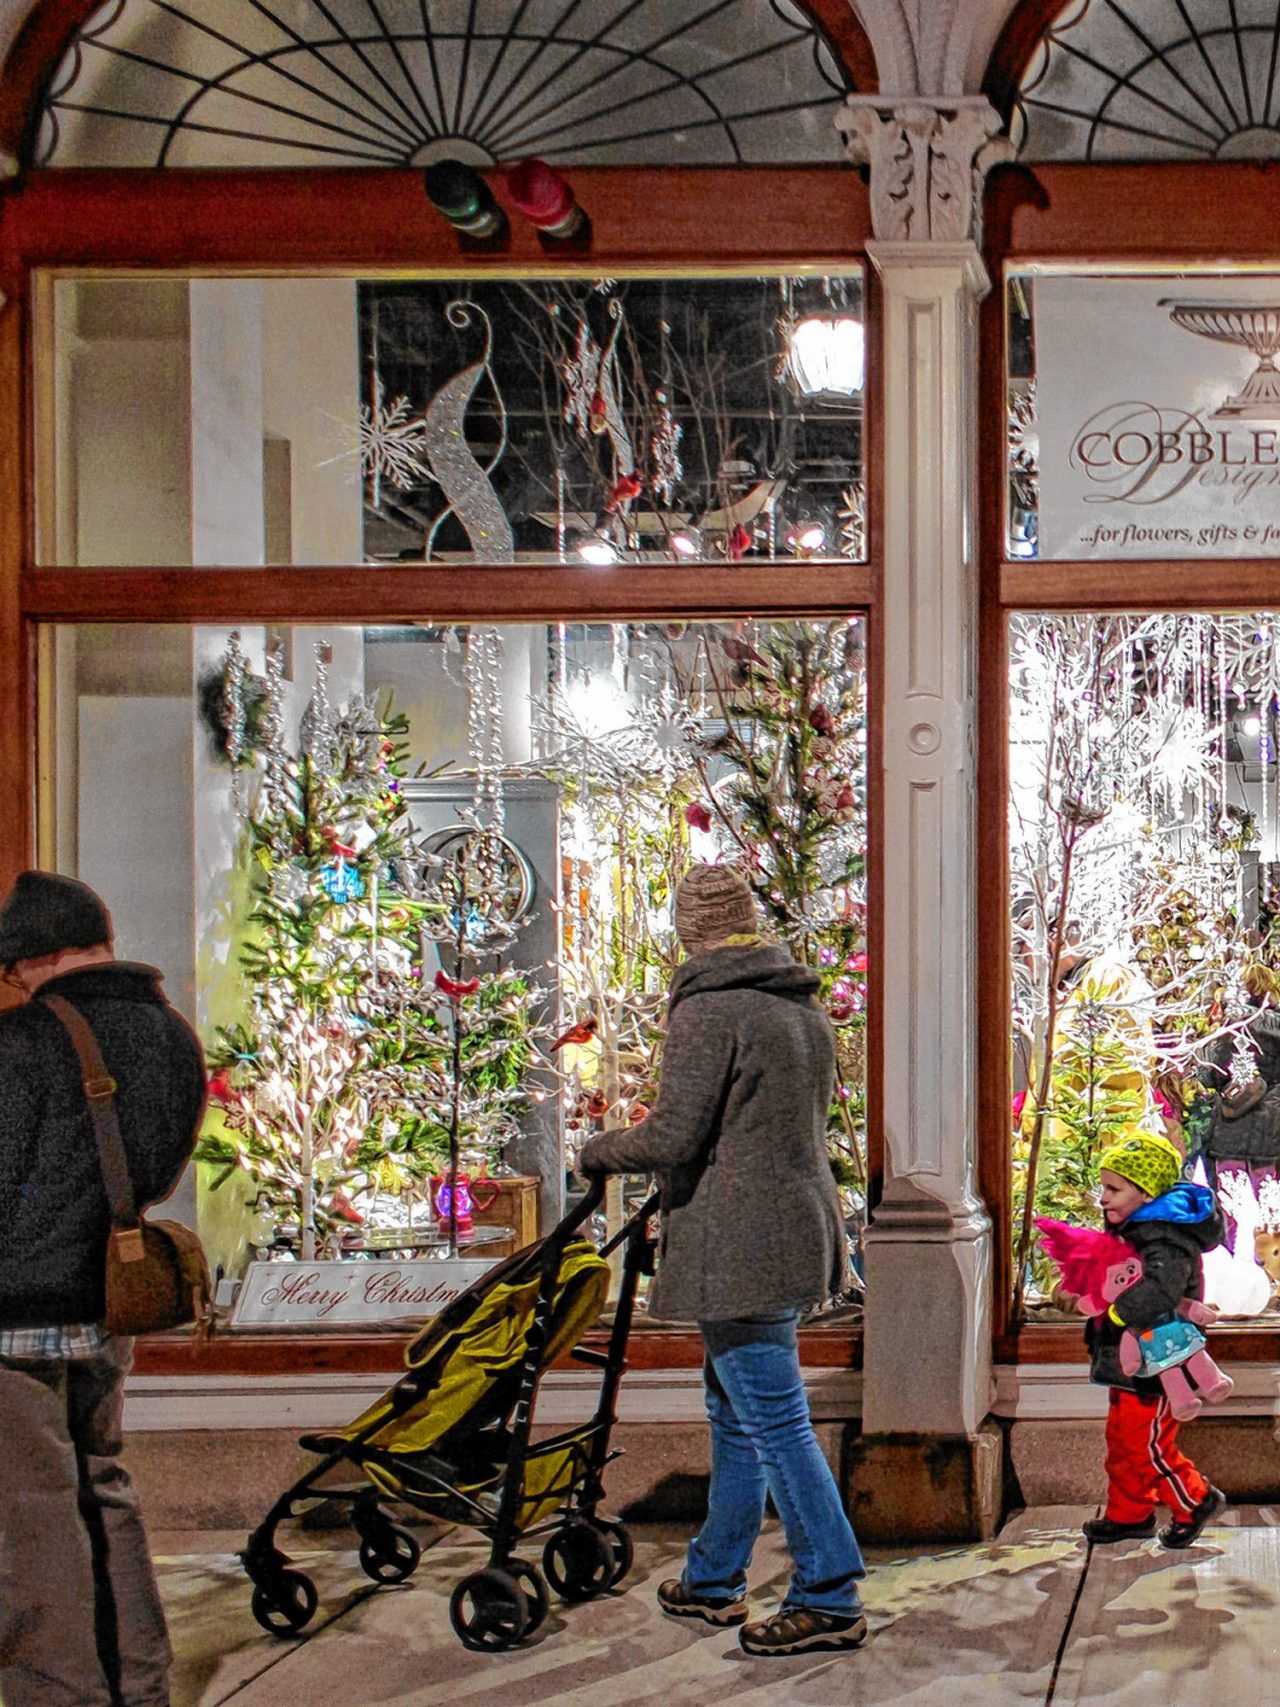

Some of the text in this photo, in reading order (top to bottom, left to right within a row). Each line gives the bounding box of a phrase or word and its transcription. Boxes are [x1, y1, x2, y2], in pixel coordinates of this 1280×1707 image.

[1120, 524, 1193, 547] flowers,
[1197, 524, 1238, 546] gifts
[1243, 525, 1259, 540] &
[261, 1271, 459, 1317] Merry Christm
[517, 1295, 547, 1423] LITEAY
